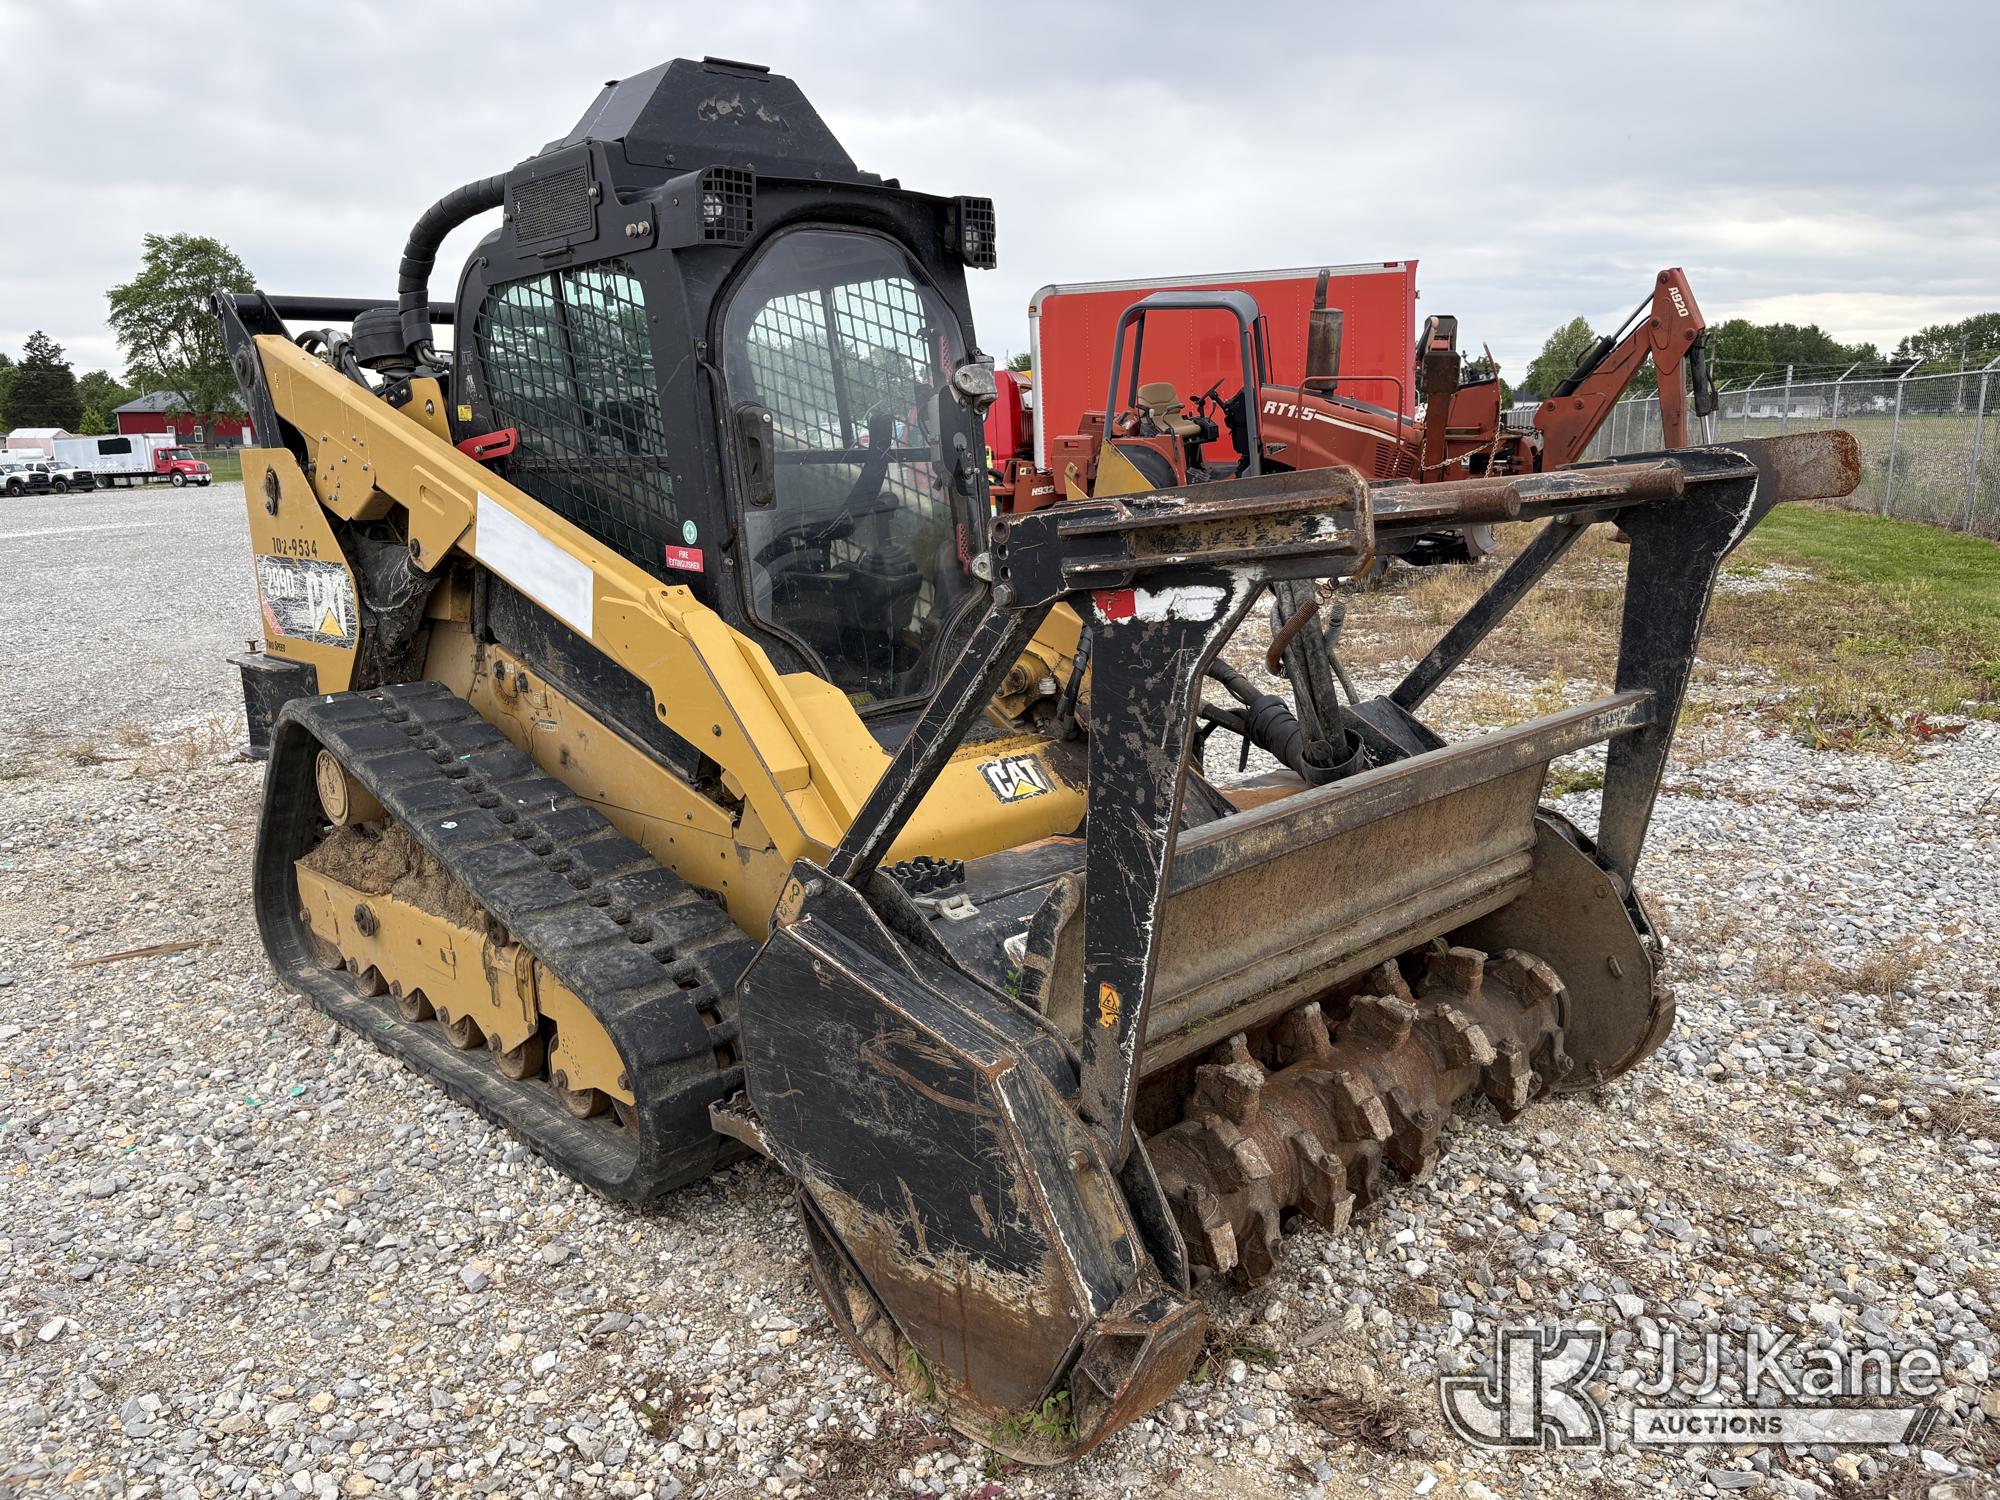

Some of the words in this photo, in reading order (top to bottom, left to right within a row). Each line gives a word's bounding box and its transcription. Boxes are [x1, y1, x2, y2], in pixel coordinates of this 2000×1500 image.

[1668, 286, 1689, 318] A920
[1031, 485, 1055, 497] H932
[272, 536, 318, 559] 102-9534
[678, 550, 689, 559] FIRE
[265, 566, 296, 599] 299D
[986, 758, 1047, 799] CAT
